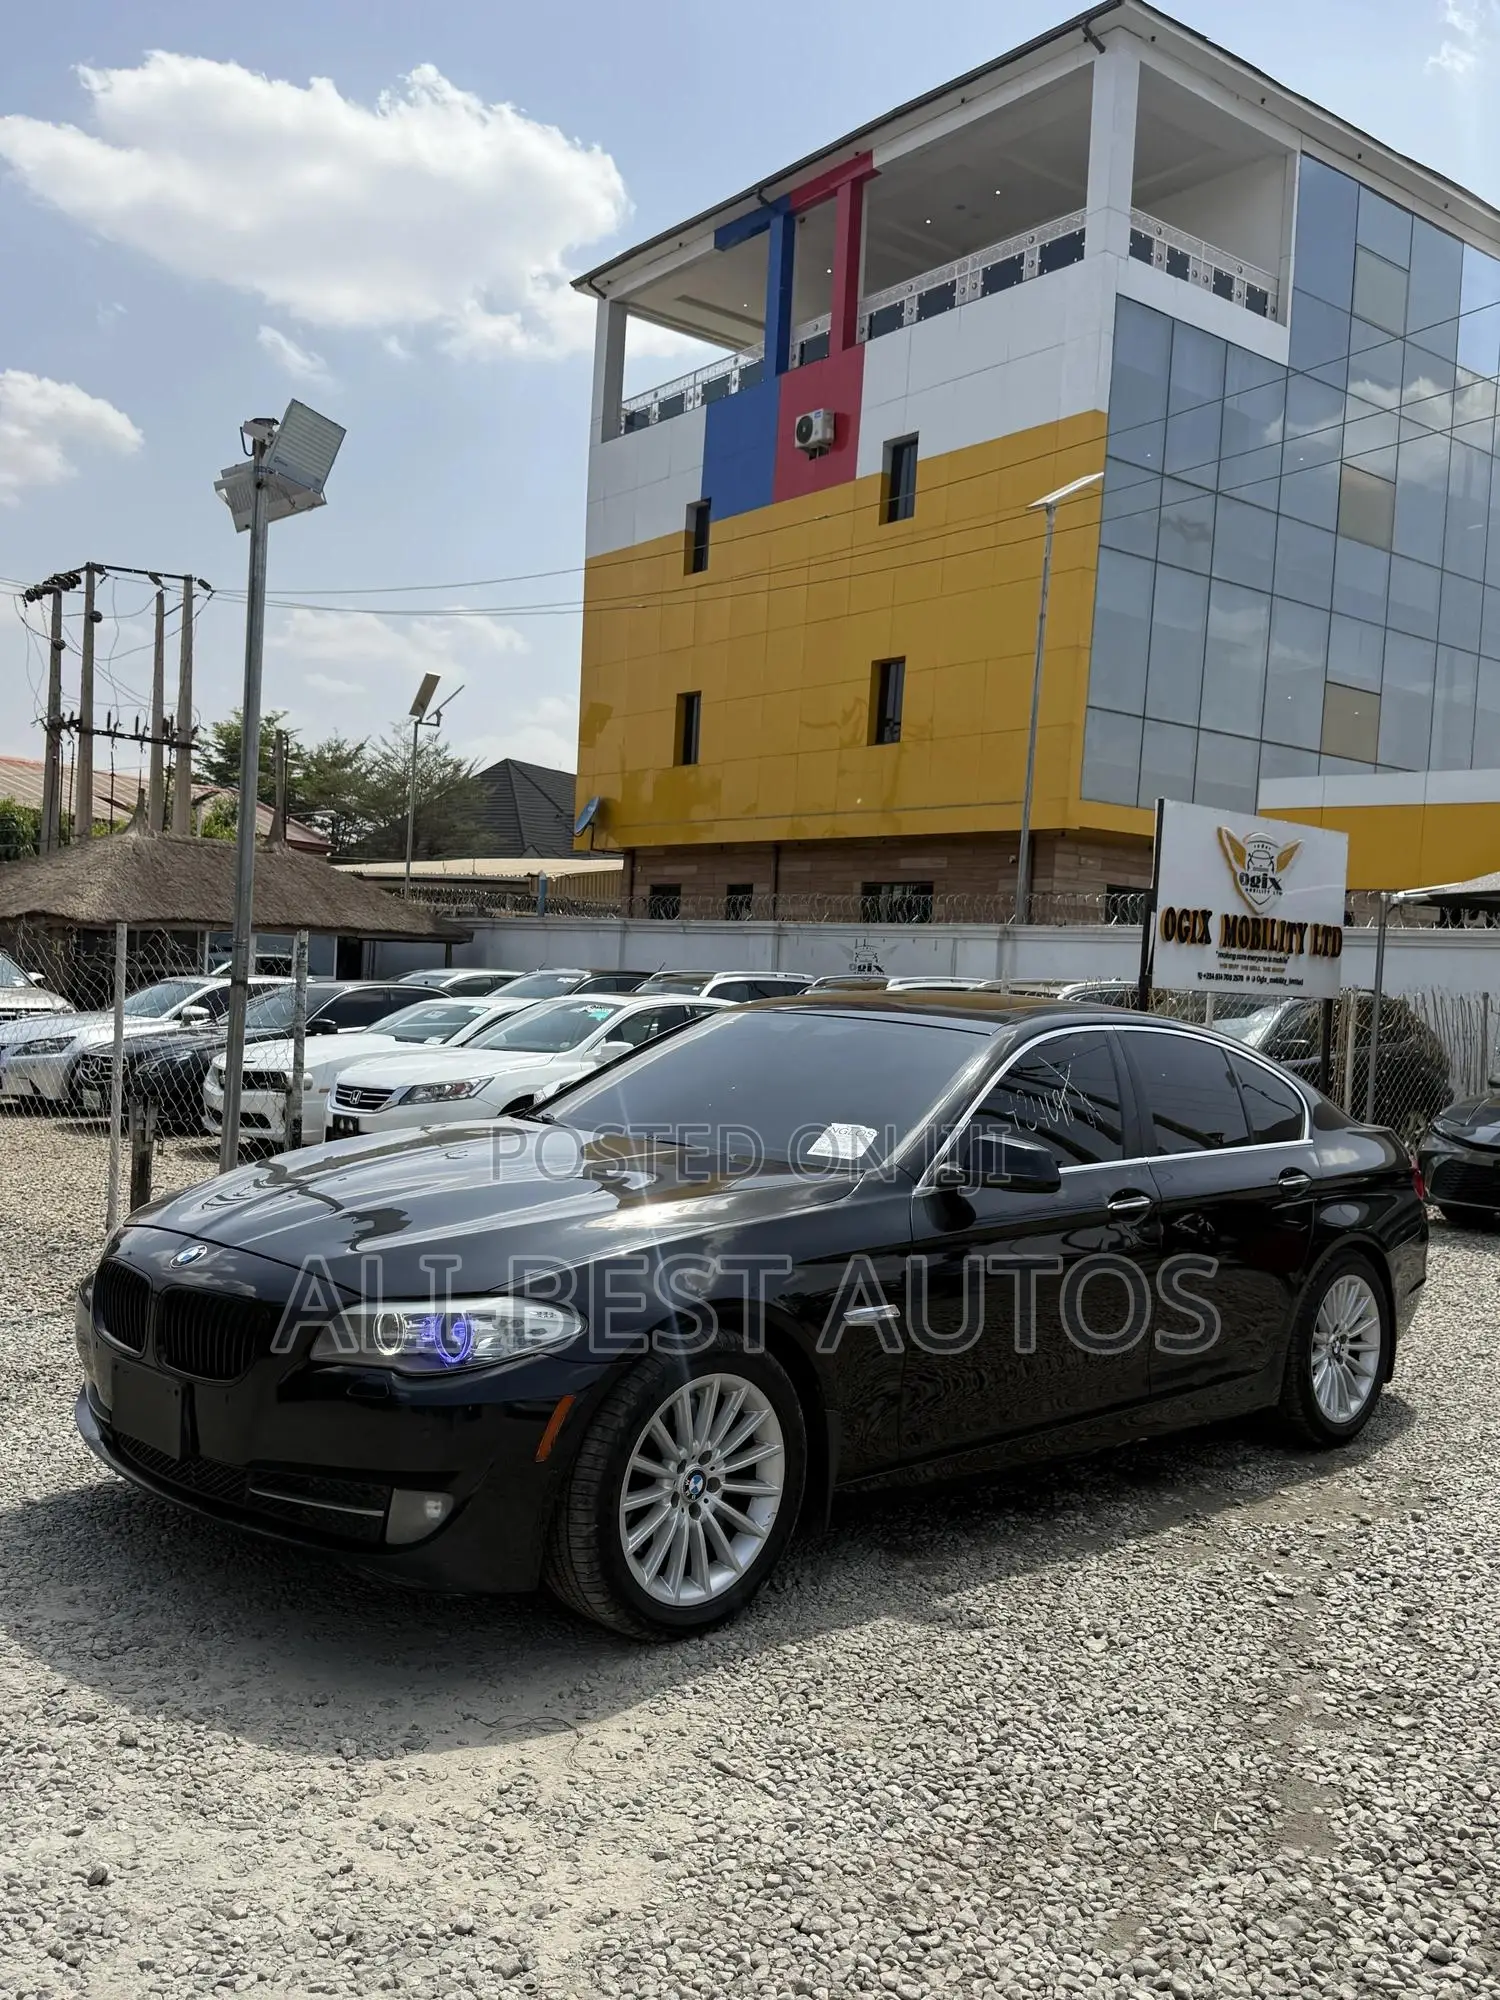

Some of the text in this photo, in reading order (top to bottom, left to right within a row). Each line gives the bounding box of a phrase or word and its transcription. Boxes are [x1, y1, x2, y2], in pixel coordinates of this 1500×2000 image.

[1239, 872, 1282, 891] Ogix
[1160, 906, 1343, 959] OGIX MOBILITY LTD
